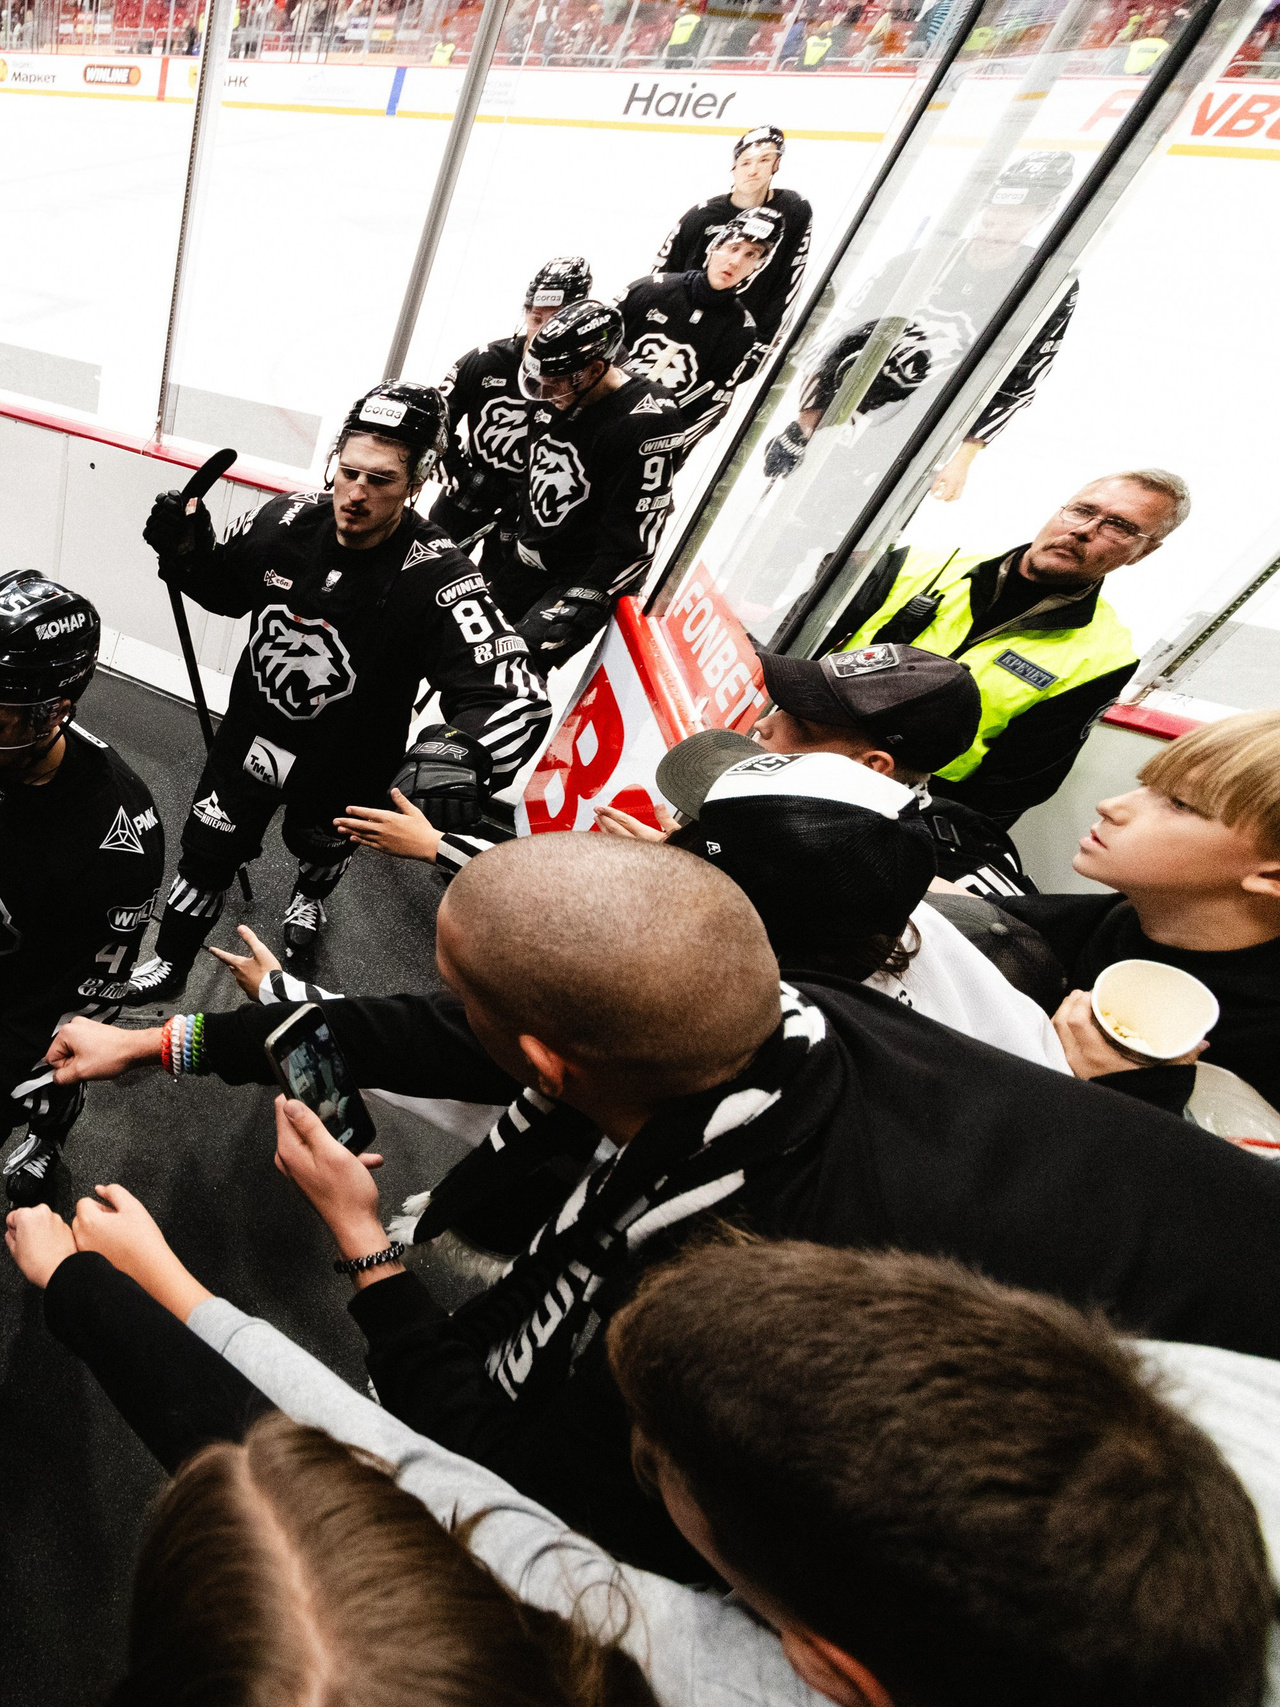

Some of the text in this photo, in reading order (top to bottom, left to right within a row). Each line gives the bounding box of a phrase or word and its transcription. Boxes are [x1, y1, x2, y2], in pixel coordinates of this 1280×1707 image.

[11, 71, 56, 84] Маркет
[86, 66, 130, 83] WINLINE
[623, 82, 737, 119] Haier
[364, 403, 403, 420] согаз
[673, 581, 766, 728] FONBET
[1001, 654, 1052, 685] КРЕЧЕТ
